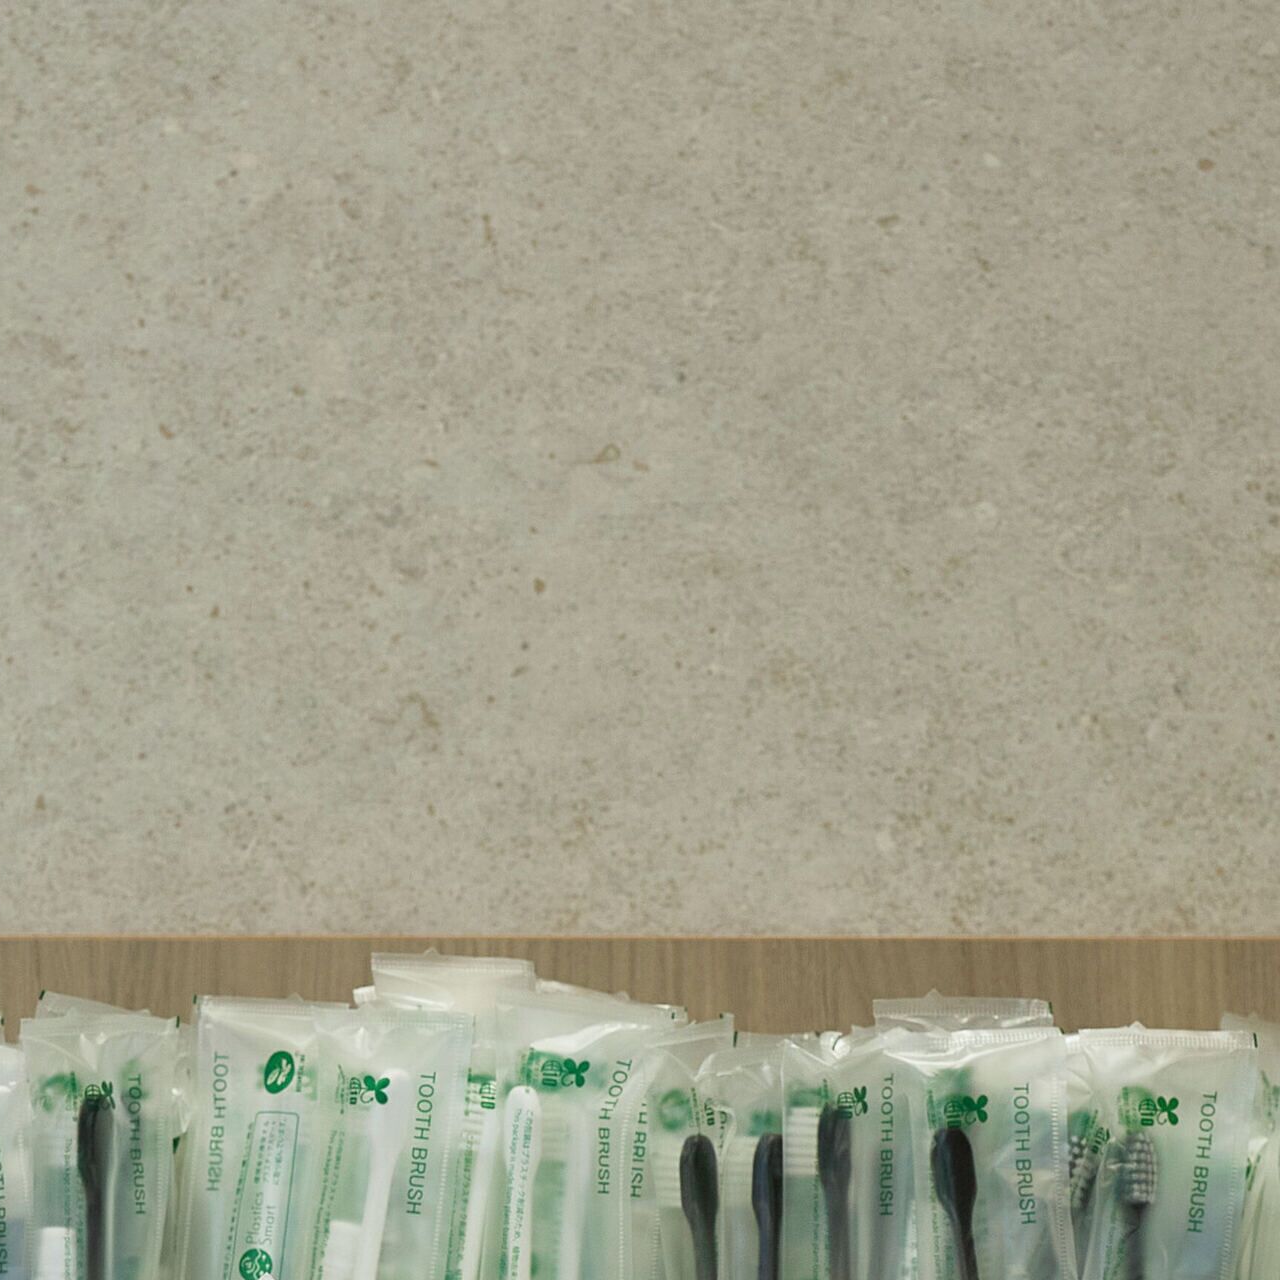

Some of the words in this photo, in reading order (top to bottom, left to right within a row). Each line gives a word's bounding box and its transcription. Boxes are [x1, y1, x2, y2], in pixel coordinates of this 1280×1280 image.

[128, 1073, 143, 1141] TOOTH
[413, 1071, 437, 1140] TOOTH
[598, 1058, 633, 1121] TOOTH
[880, 1072, 894, 1142] TOOTH
[1013, 1081, 1031, 1152] TOOTH
[1195, 1090, 1218, 1159] TOOTH
[129, 1148, 147, 1215] BRUSH
[405, 1146, 429, 1215] BRUSH
[597, 1126, 611, 1195] BRUSH
[879, 1148, 894, 1216] BRUSH
[1015, 1158, 1037, 1225] BRUSH
[245, 1191, 264, 1244] Plastics
[260, 1204, 276, 1245] Smart
[1186, 1165, 1210, 1233] BRUSH
